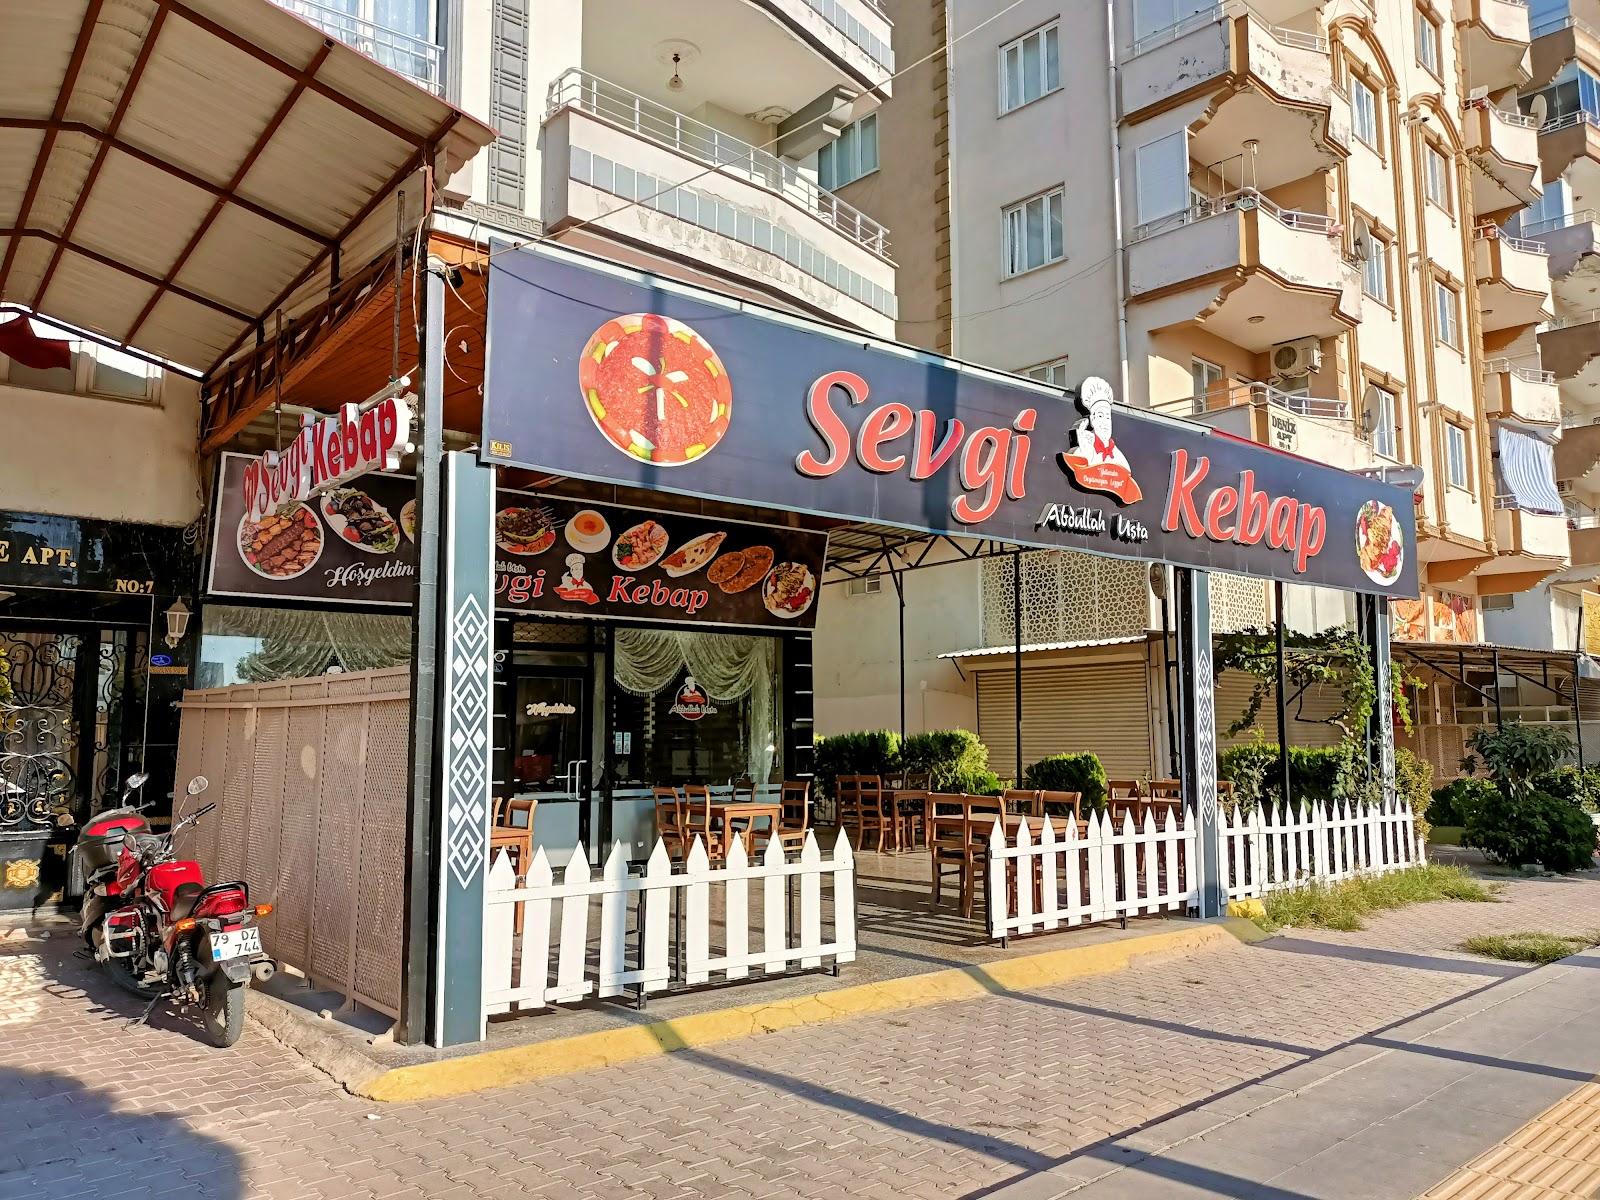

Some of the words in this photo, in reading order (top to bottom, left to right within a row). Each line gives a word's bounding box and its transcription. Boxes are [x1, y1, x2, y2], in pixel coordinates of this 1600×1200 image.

[312, 397, 401, 487] Kebap
[796, 370, 1037, 525] Sevgi
[258, 412, 313, 515] Sevgi
[1041, 503, 1106, 532] Abdullah
[1115, 512, 1149, 540] Usta
[1161, 448, 1327, 573] Kebap
[21, 546, 77, 568] APT.
[115, 579, 154, 593] NO:7
[606, 575, 709, 614] Kebap
[212, 934, 229, 947] 79
[241, 928, 258, 941] DZ
[234, 941, 260, 955] 744
